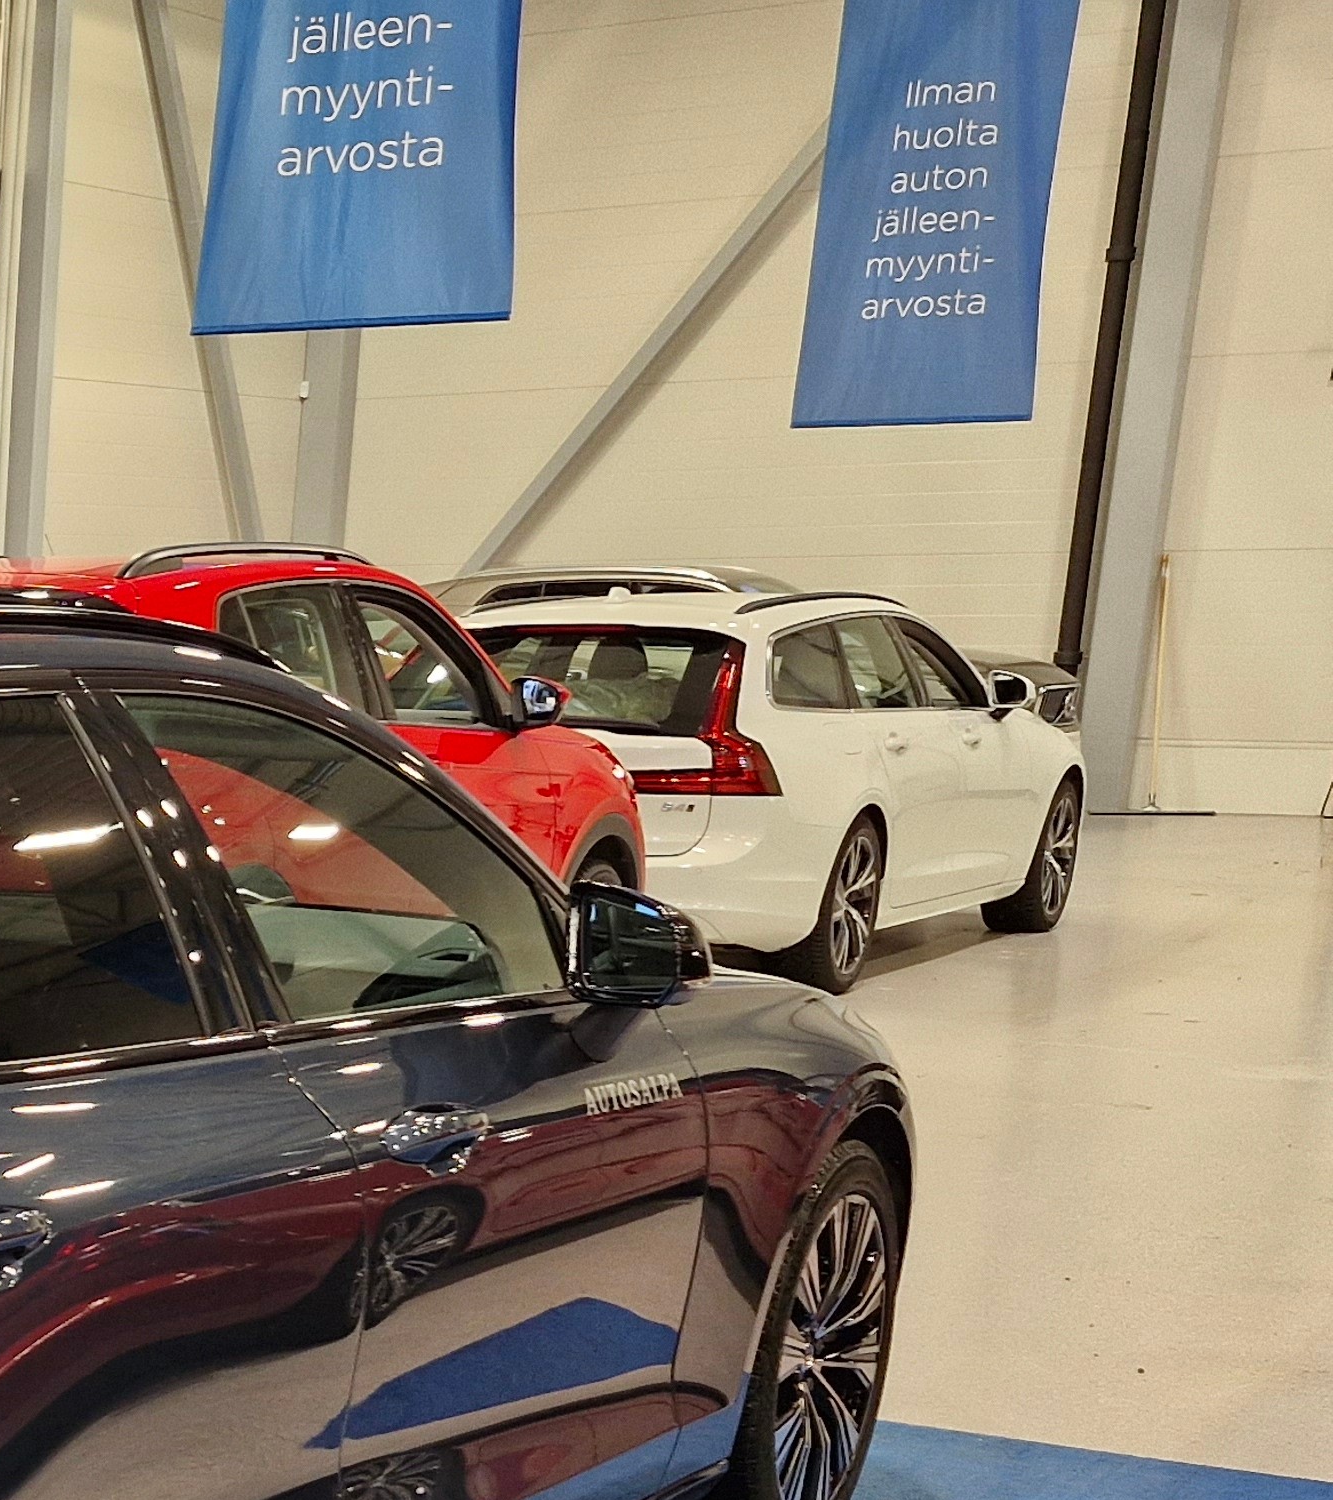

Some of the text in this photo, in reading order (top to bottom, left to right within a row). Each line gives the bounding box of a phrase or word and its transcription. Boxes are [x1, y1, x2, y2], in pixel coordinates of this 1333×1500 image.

[286, 11, 454, 63] jälleen-
[280, 65, 454, 122] myynti-
[905, 79, 996, 109] Ilman
[277, 130, 445, 176] arvosta
[892, 117, 999, 152] huolta
[890, 164, 988, 194] auton
[871, 205, 996, 243] jälleen-
[865, 244, 996, 283] myynti-
[861, 289, 987, 320] arvosta
[583, 1072, 684, 1116] AUTOSALPA
